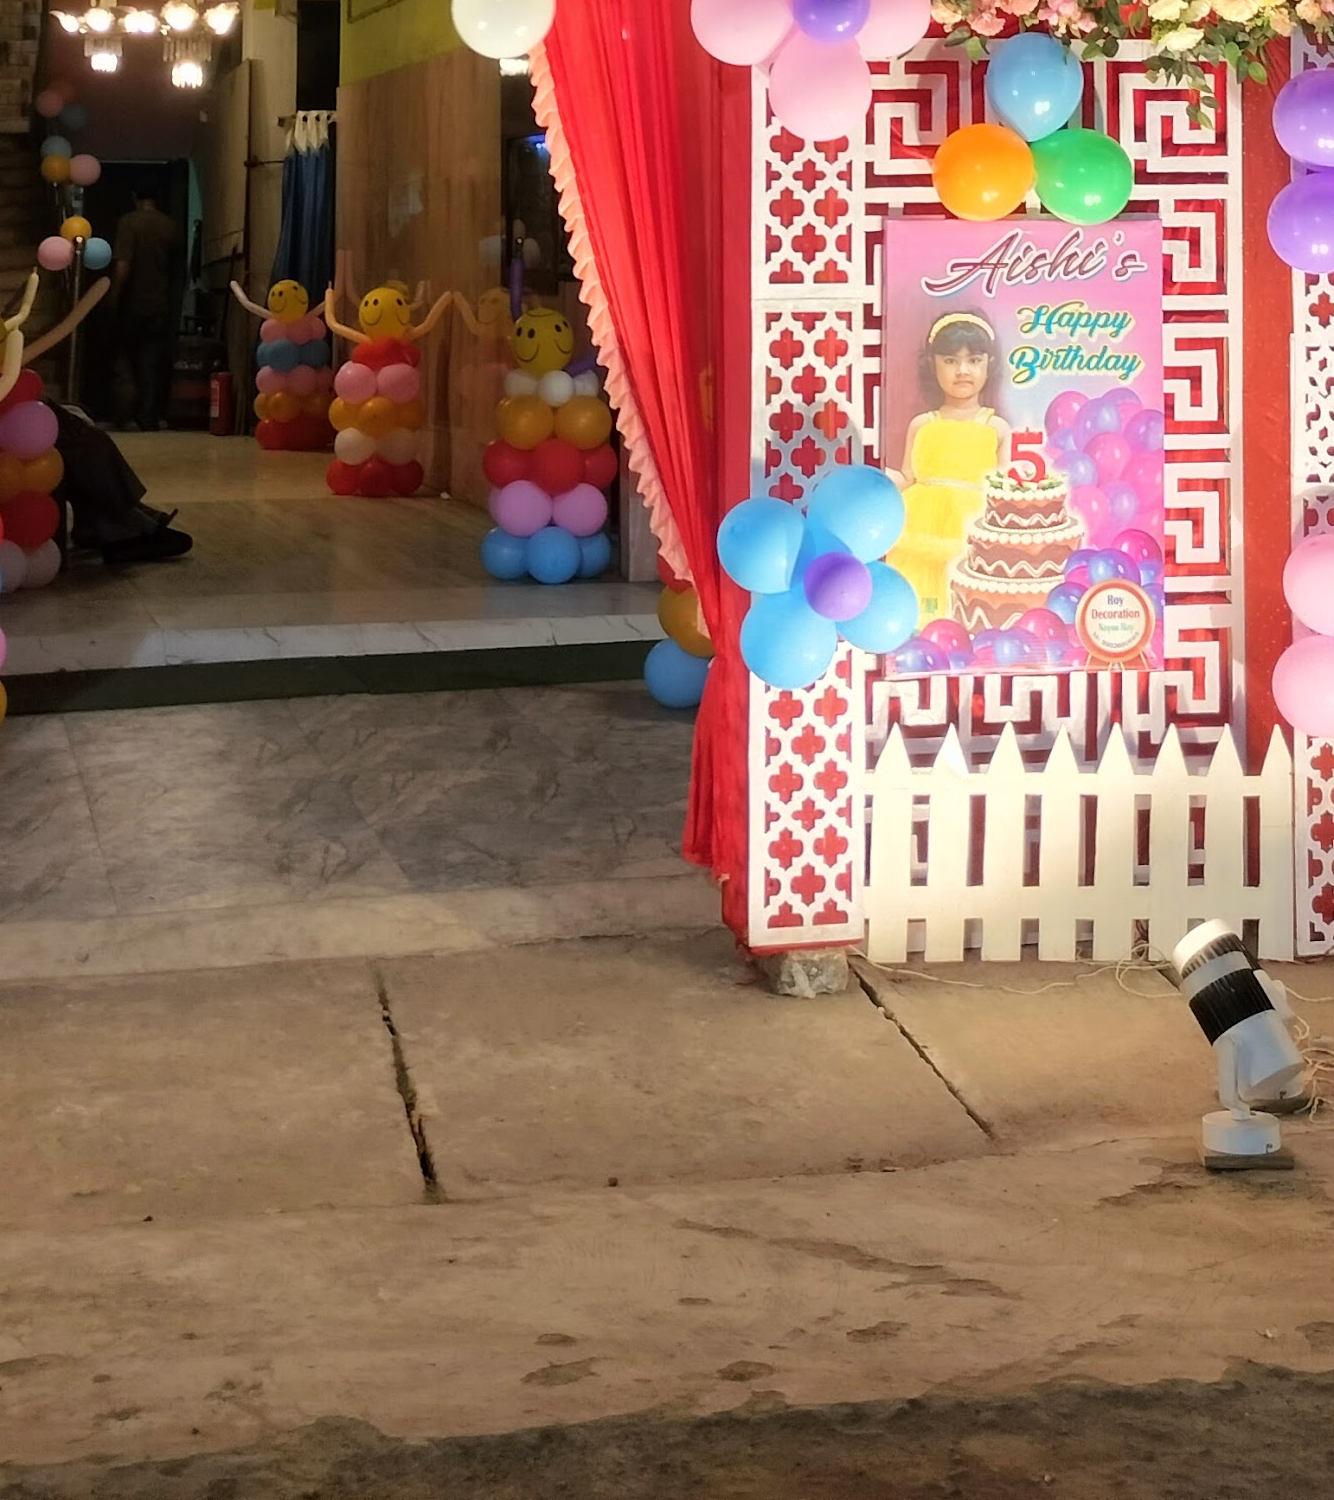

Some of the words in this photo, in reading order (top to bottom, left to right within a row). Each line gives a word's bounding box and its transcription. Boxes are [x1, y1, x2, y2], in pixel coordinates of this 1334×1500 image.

[923, 229, 1146, 294] Aishi's
[1017, 301, 1132, 338] Happy
[1008, 344, 1142, 384] Birthday
[1007, 430, 1047, 487] 5
[1091, 608, 1140, 620] Decoration
[1107, 594, 1123, 607] Roy
